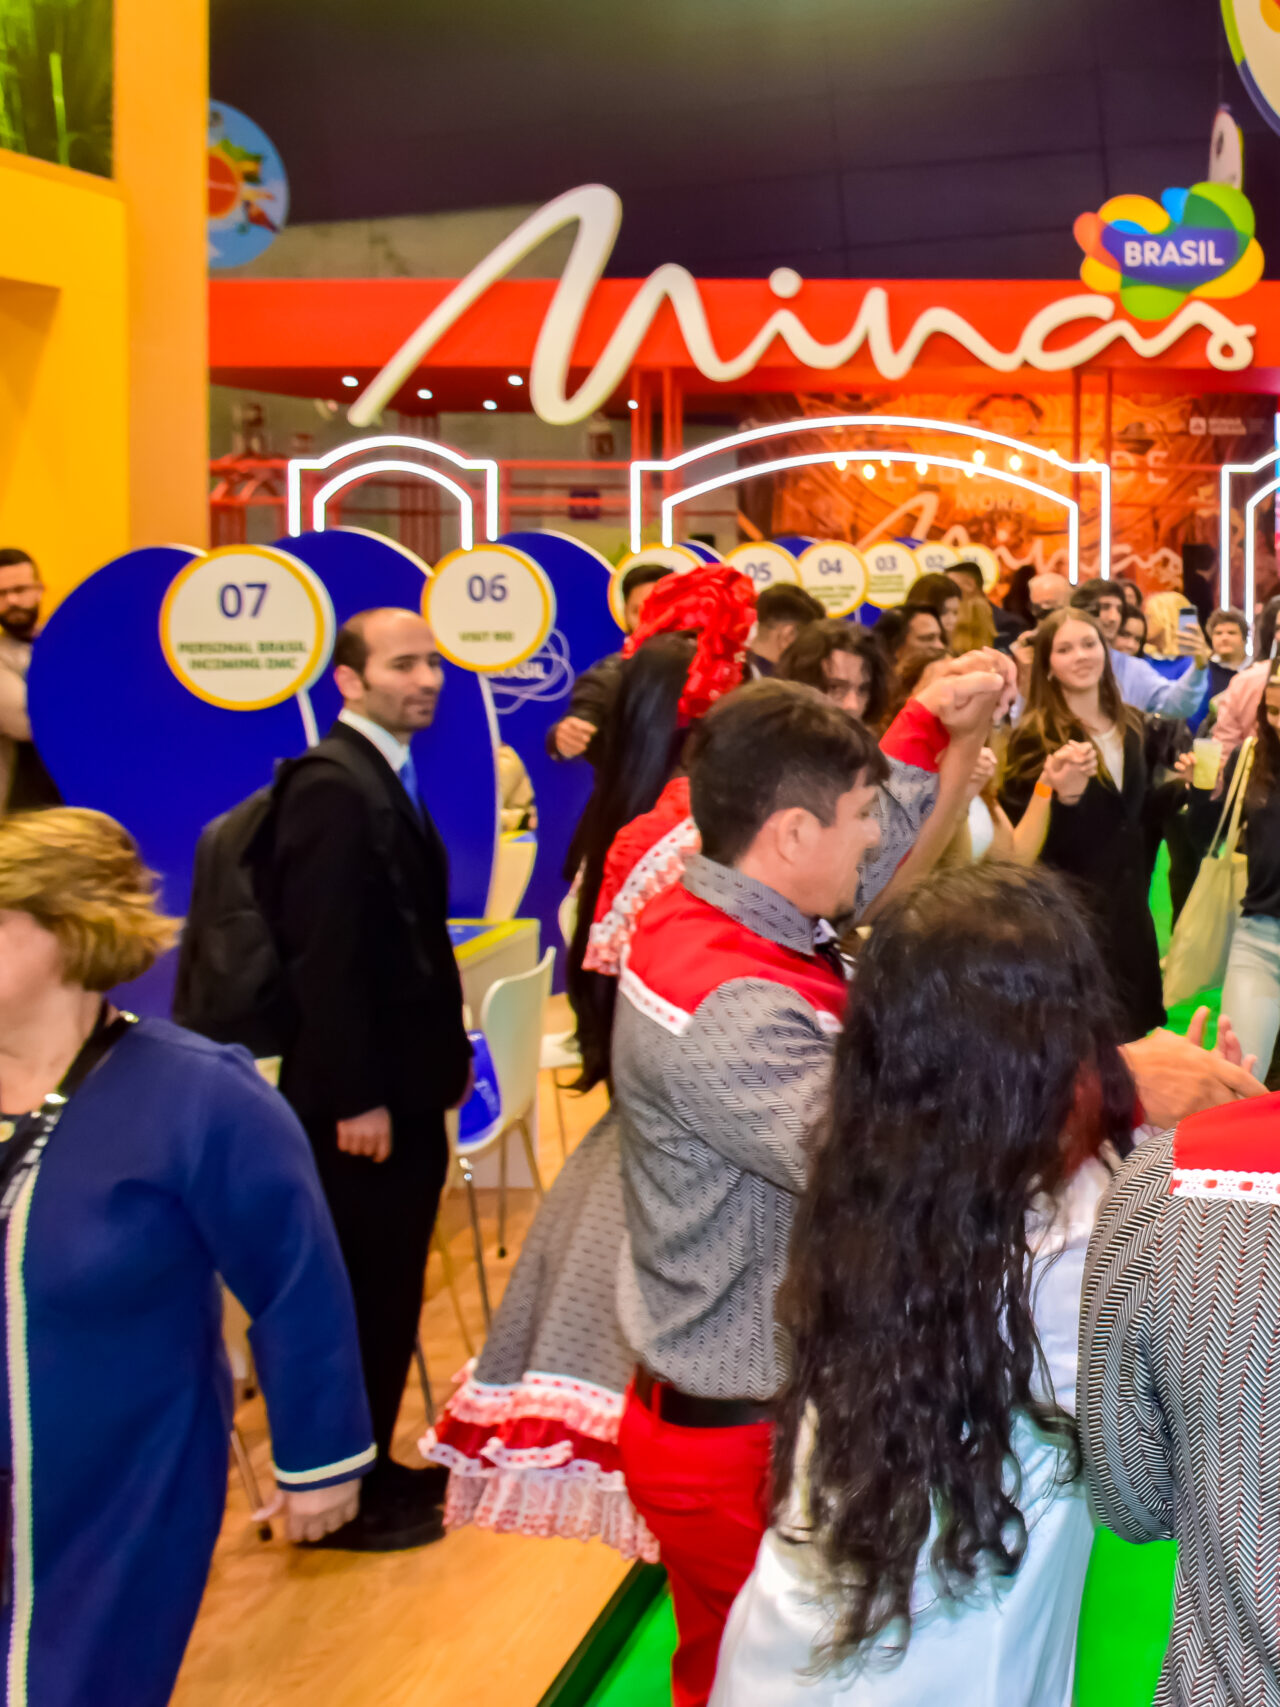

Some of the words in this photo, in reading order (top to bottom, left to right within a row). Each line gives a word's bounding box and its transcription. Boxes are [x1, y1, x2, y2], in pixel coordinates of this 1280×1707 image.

[1124, 239, 1225, 267] BRASIL
[347, 183, 1257, 427] Minas
[744, 562, 772, 581] 05
[818, 558, 843, 575] 04
[876, 556, 898, 571] 03
[468, 574, 508, 602] 06
[219, 582, 269, 618] 07
[178, 641, 252, 654] PERSONAL
[258, 641, 307, 653] BRASIL
[189, 658, 261, 671] INCOMING
[265, 657, 298, 670] DMC
